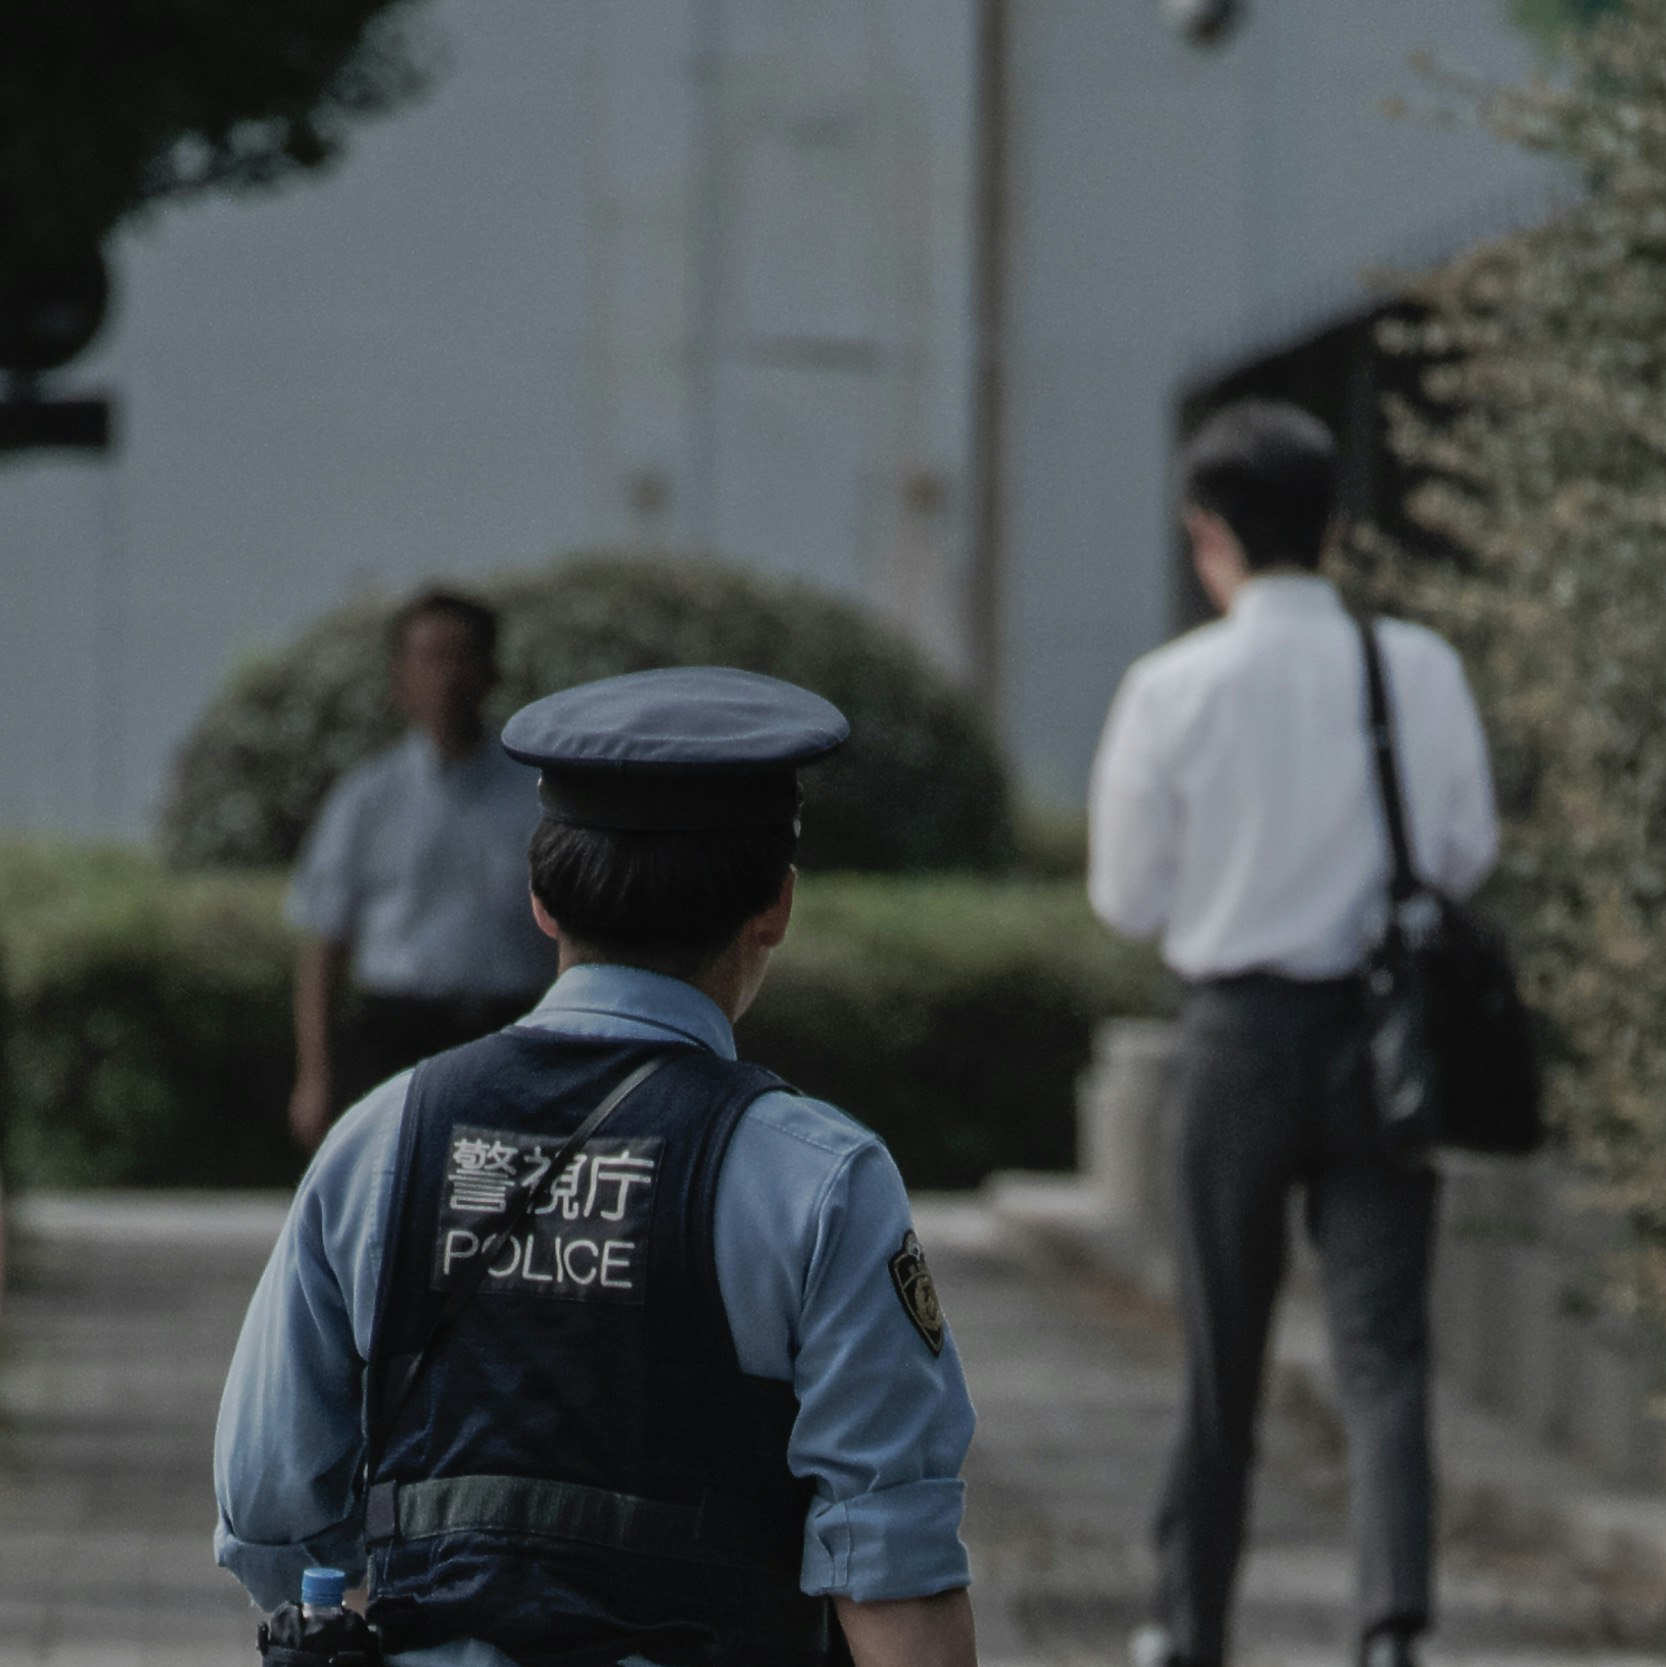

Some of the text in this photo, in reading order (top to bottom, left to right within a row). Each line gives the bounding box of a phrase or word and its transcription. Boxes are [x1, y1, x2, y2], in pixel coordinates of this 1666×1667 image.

[448, 1139, 655, 1220] 警視庁
[443, 1230, 636, 1289] POLICE
